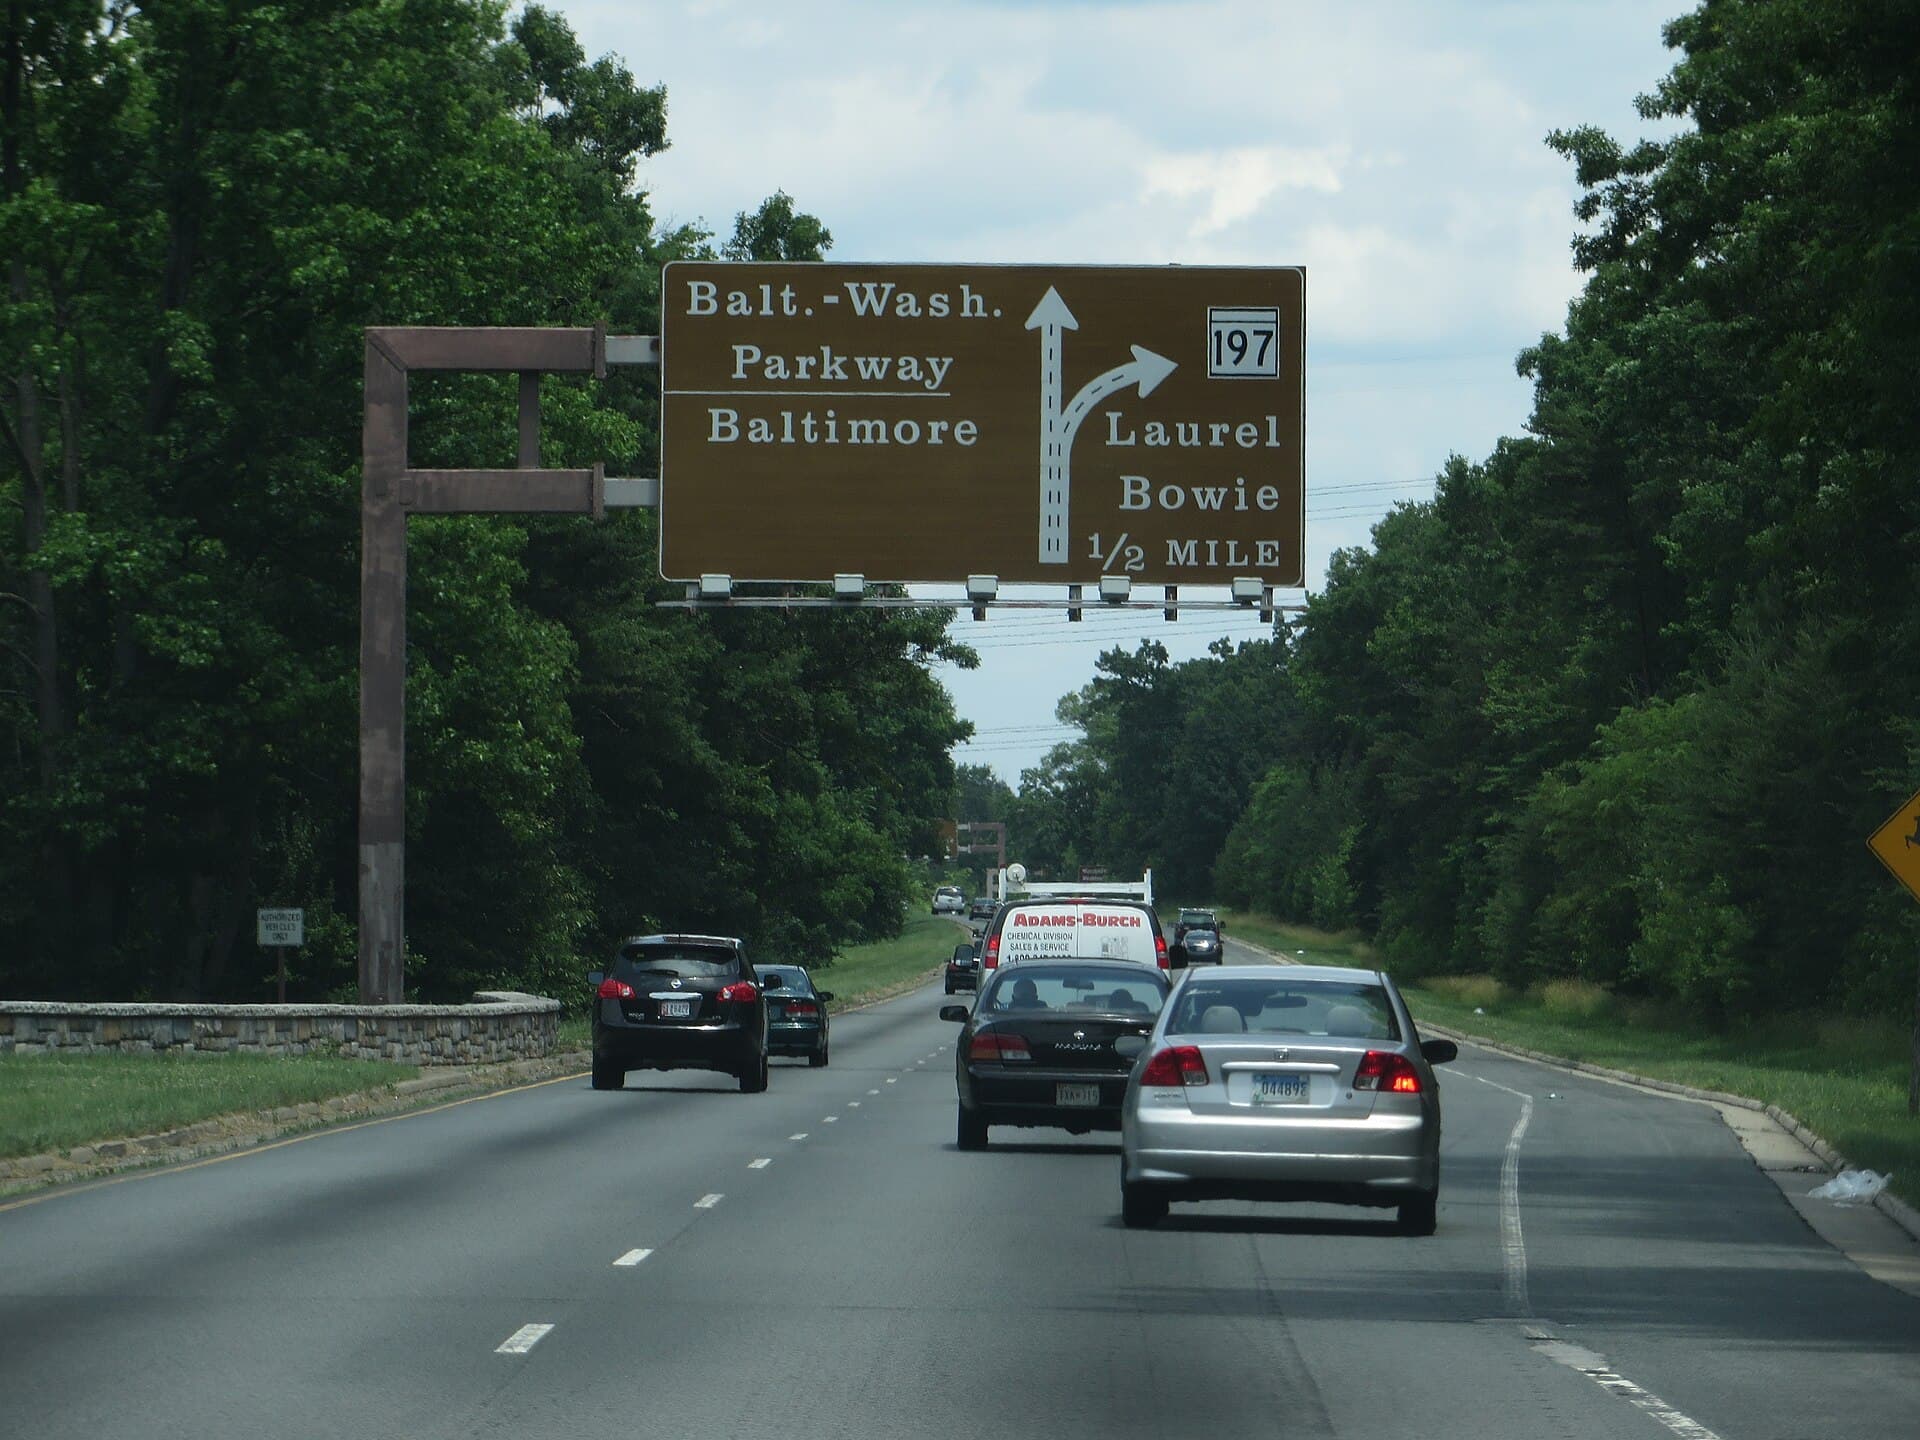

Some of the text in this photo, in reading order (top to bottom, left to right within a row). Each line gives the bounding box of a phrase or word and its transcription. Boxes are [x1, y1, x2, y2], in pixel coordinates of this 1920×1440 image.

[1214, 330, 1273, 366] 197
[731, 344, 953, 390] Parkway
[707, 408, 978, 446] Baltimore
[1105, 411, 1280, 448] Laurel
[1119, 475, 1279, 511] Bowie
[1088, 532, 1279, 571] 1/2 MILE
[1007, 931, 1073, 941] CHEMICAL DIVISION
[1013, 913, 1141, 928] ADAMS-BURCH
[1010, 943, 1032, 951] SALES
[1040, 943, 1069, 951] SERVICE
